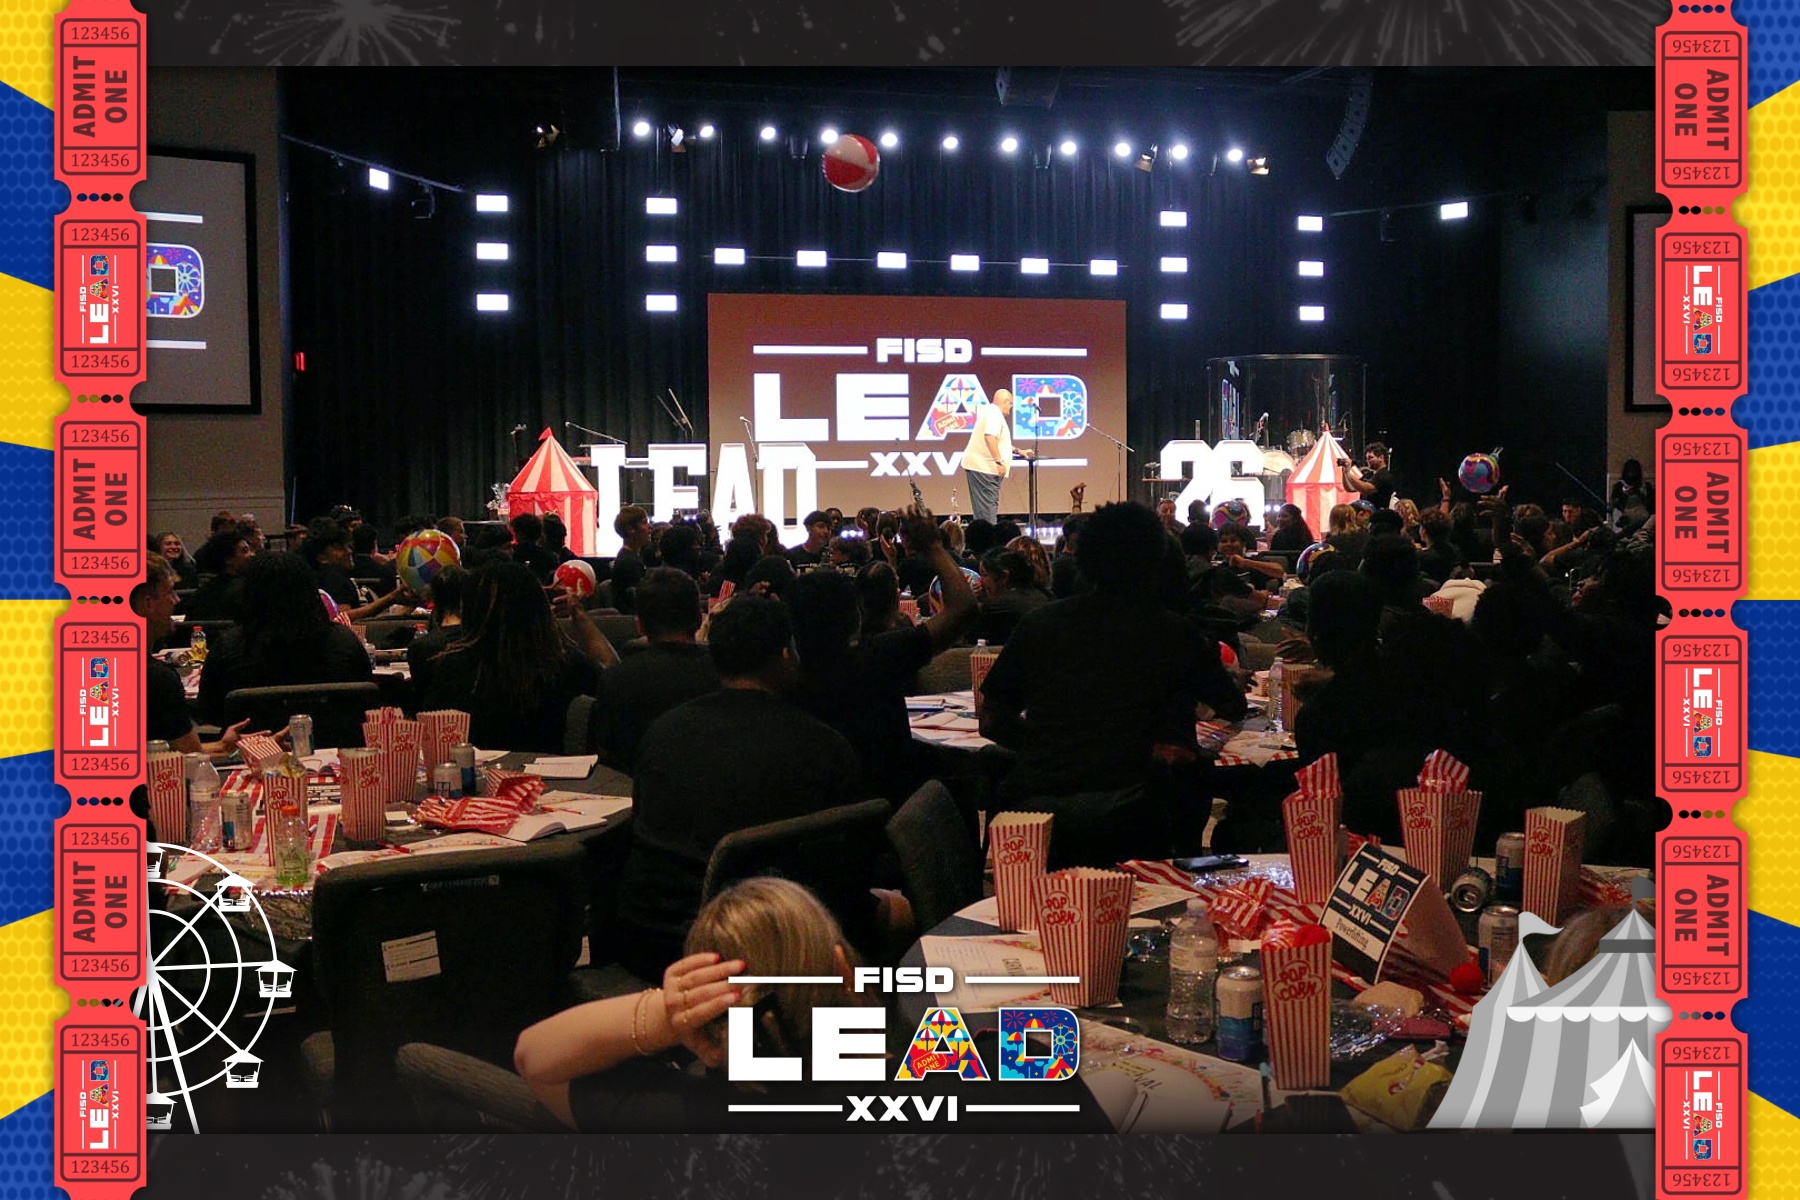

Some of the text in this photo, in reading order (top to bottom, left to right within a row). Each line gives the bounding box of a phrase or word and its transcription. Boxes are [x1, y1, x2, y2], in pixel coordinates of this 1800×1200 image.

[876, 338, 972, 363] FISD
[753, 372, 1087, 441] LEAD
[870, 451, 964, 476] XXV
[1160, 440, 1265, 531] 26
[590, 443, 816, 557] LEAD
[157, 771, 173, 783] POP
[361, 767, 375, 779] POP
[155, 779, 179, 792] CORN
[271, 790, 288, 800] POP
[1409, 806, 1425, 817] POP
[1297, 815, 1316, 826] POP
[1297, 826, 1323, 840] CORN
[1533, 831, 1549, 842] POP
[1003, 840, 1025, 853] POP
[1530, 845, 1553, 858] CORN
[1001, 850, 1031, 865] CORN
[1338, 861, 1411, 921] LEAD
[1045, 897, 1067, 910] POP
[1045, 910, 1076, 925] CORN
[1349, 904, 1372, 925] XXVI
[1281, 966, 1306, 982] POP
[1280, 982, 1316, 1001] CORN
